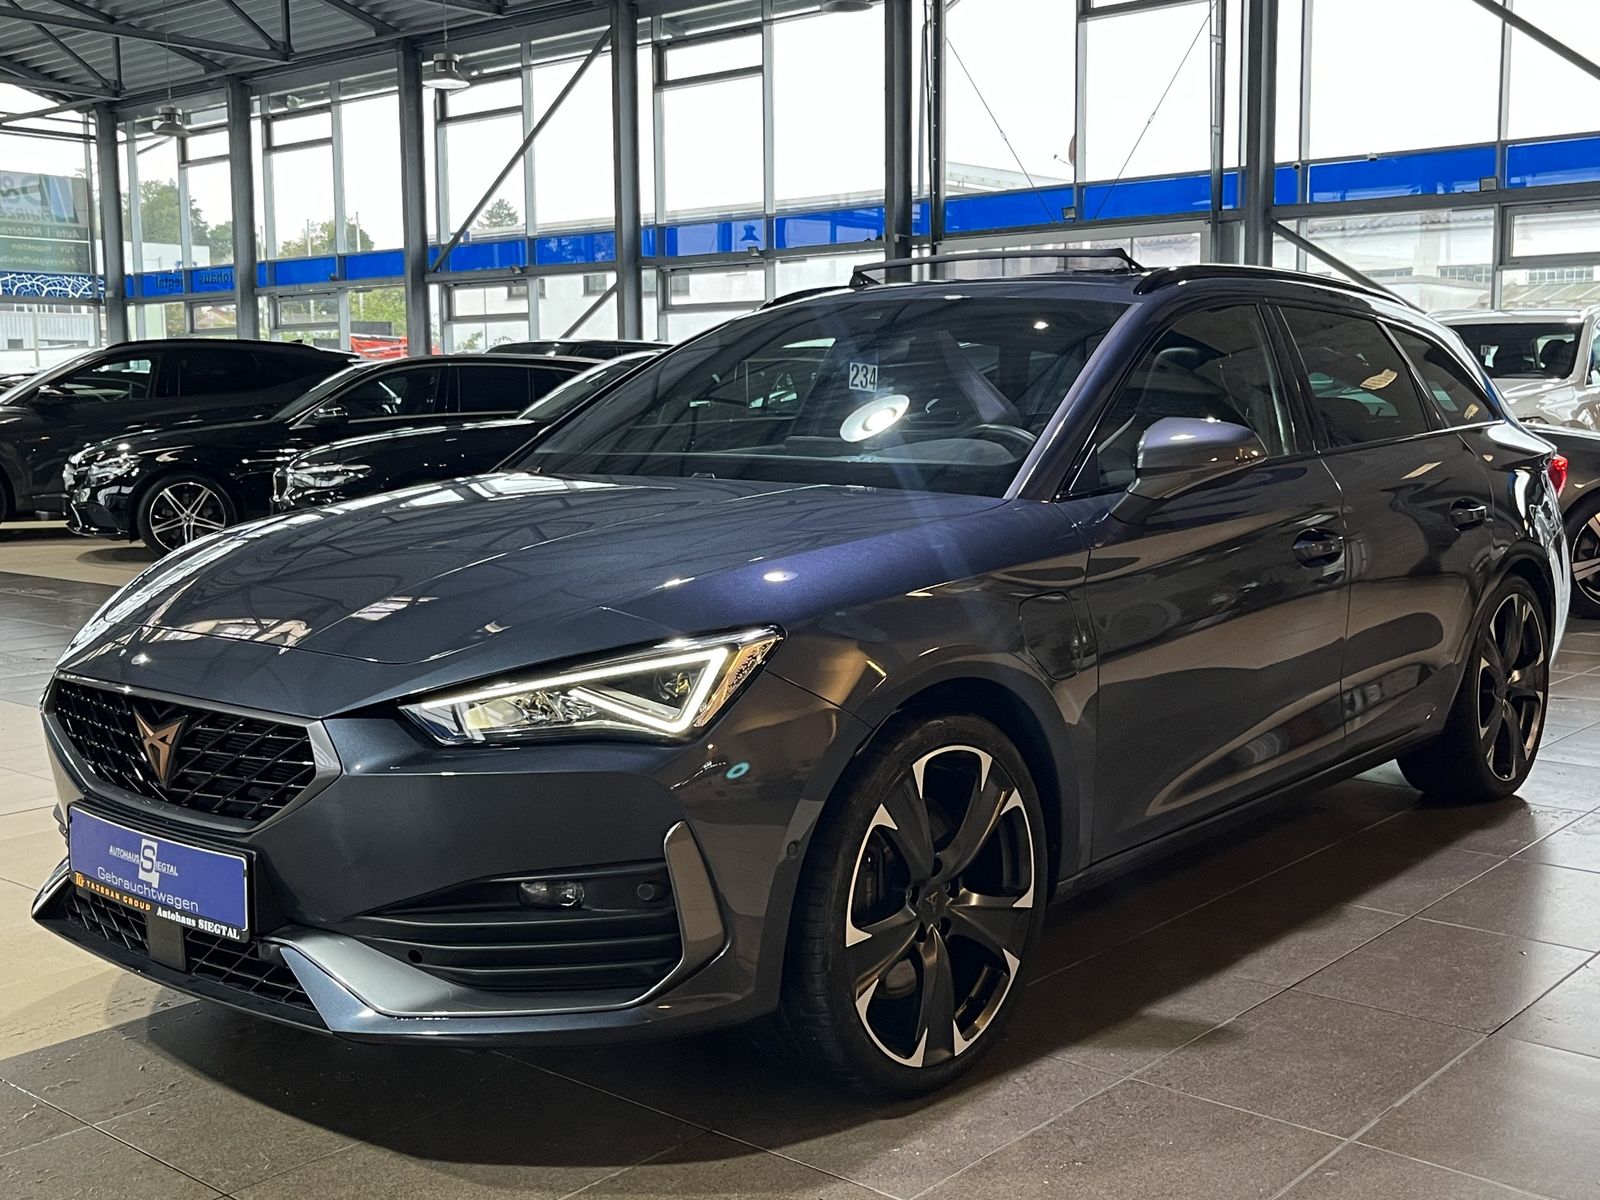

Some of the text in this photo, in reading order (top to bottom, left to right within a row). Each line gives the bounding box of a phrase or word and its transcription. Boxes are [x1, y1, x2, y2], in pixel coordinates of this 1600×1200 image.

[850, 363, 877, 390] 234
[109, 845, 140, 864] AUTOHAUS
[97, 866, 199, 913] Gebrauchtwagen
[156, 906, 240, 940] Autohaus SIEGTAL
